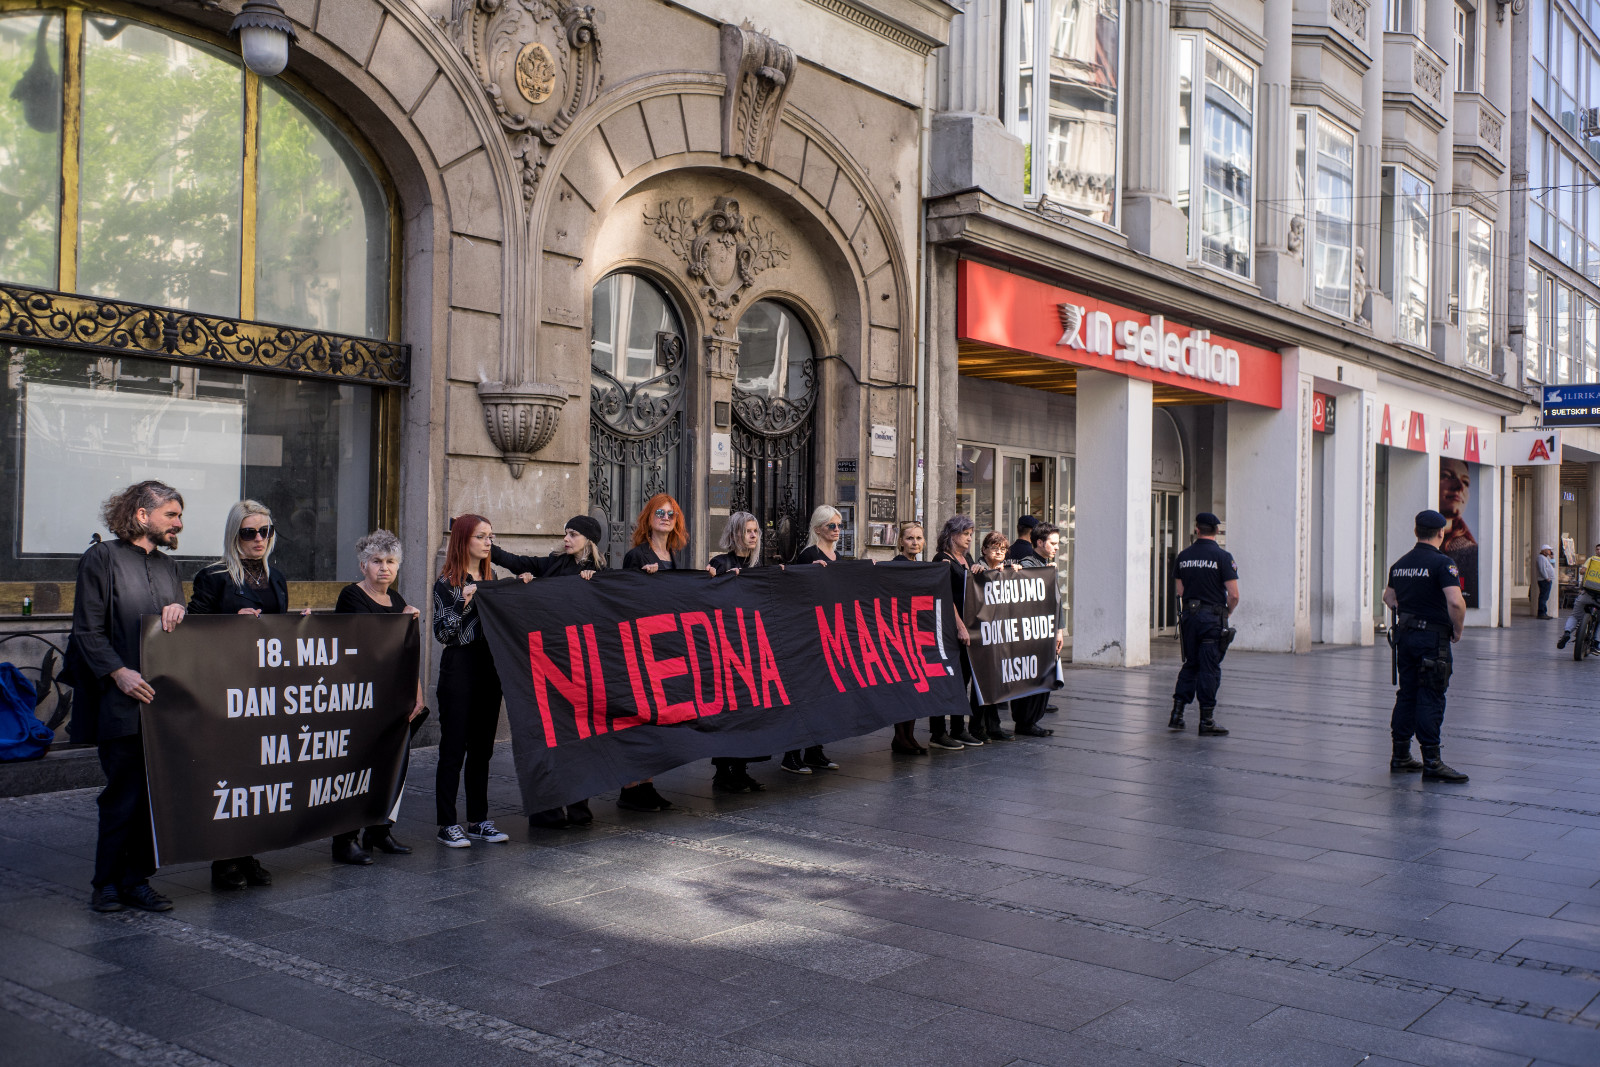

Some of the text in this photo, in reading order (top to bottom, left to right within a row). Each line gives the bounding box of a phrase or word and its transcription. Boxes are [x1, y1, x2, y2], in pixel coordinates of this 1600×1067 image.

[1115, 315, 1240, 387] selection
[1563, 392, 1600, 400] ILIRIKA
[1528, 435, 1555, 461] A1
[984, 578, 1046, 605] REAGUJMO
[981, 615, 1055, 646] DOK NE BUDE
[257, 638, 290, 668] 18.
[297, 637, 338, 667] MAJ
[528, 607, 791, 748] NIJEDNA
[1001, 655, 1038, 683] KASNO
[227, 676, 374, 719] DAN SEĆANJA
[260, 724, 351, 766] NA ŽENE
[213, 767, 372, 820] ŽRTVE NASILJA
